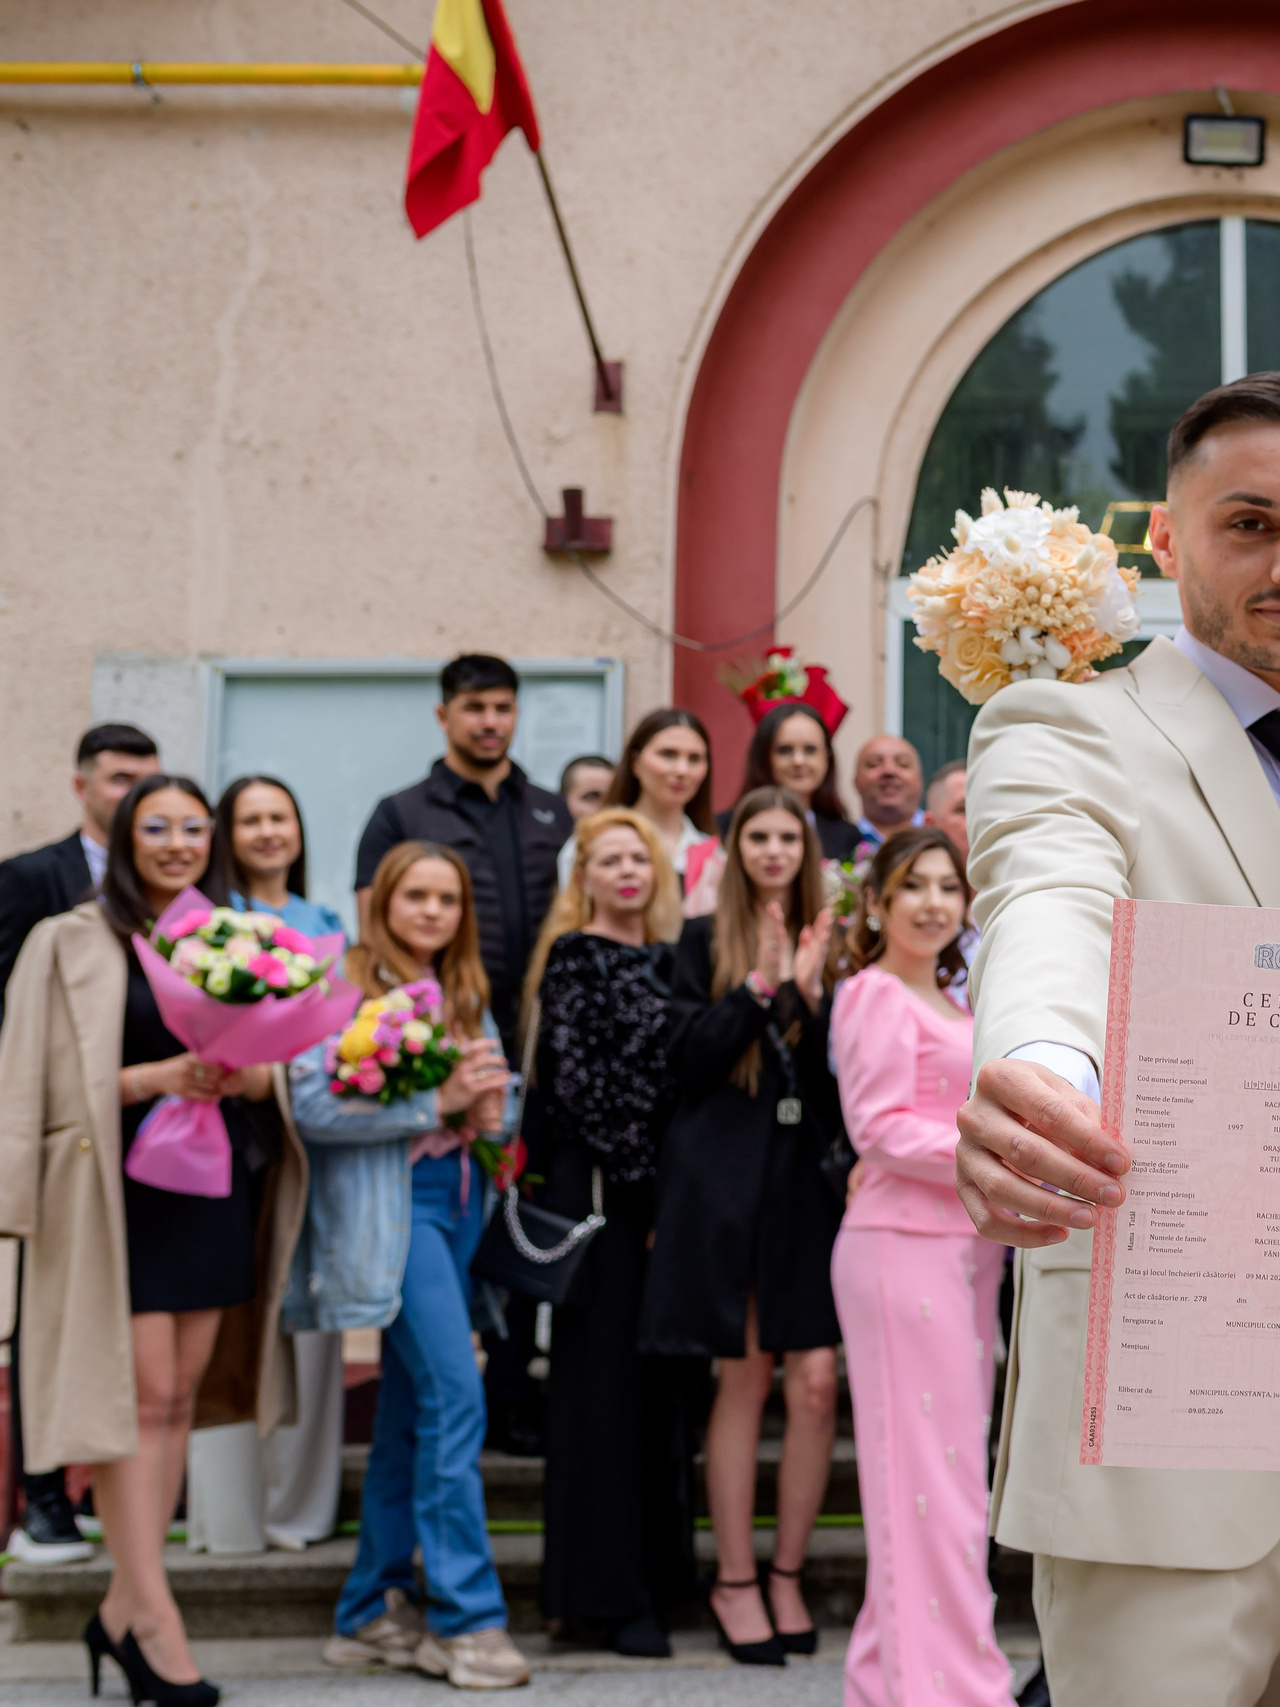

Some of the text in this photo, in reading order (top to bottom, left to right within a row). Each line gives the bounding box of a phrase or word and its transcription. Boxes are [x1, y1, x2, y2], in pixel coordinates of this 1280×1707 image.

[1228, 1010, 1257, 1027] DE
[1155, 1056, 1178, 1064] privind
[1151, 1076, 1178, 1084] numeric
[1136, 1094, 1161, 1102] Numele
[1136, 1108, 1170, 1116] Prenumele
[1132, 1166, 1148, 1174] după
[1146, 1190, 1170, 1198] privind
[1150, 1220, 1185, 1228] Prenumele
[1203, 1271, 1236, 1279] căsătoriei
[1122, 1316, 1156, 1325] Înregistrat
[1226, 1321, 1265, 1329] MUNICIPIUL
[1118, 1386, 1143, 1394] Eliberat
